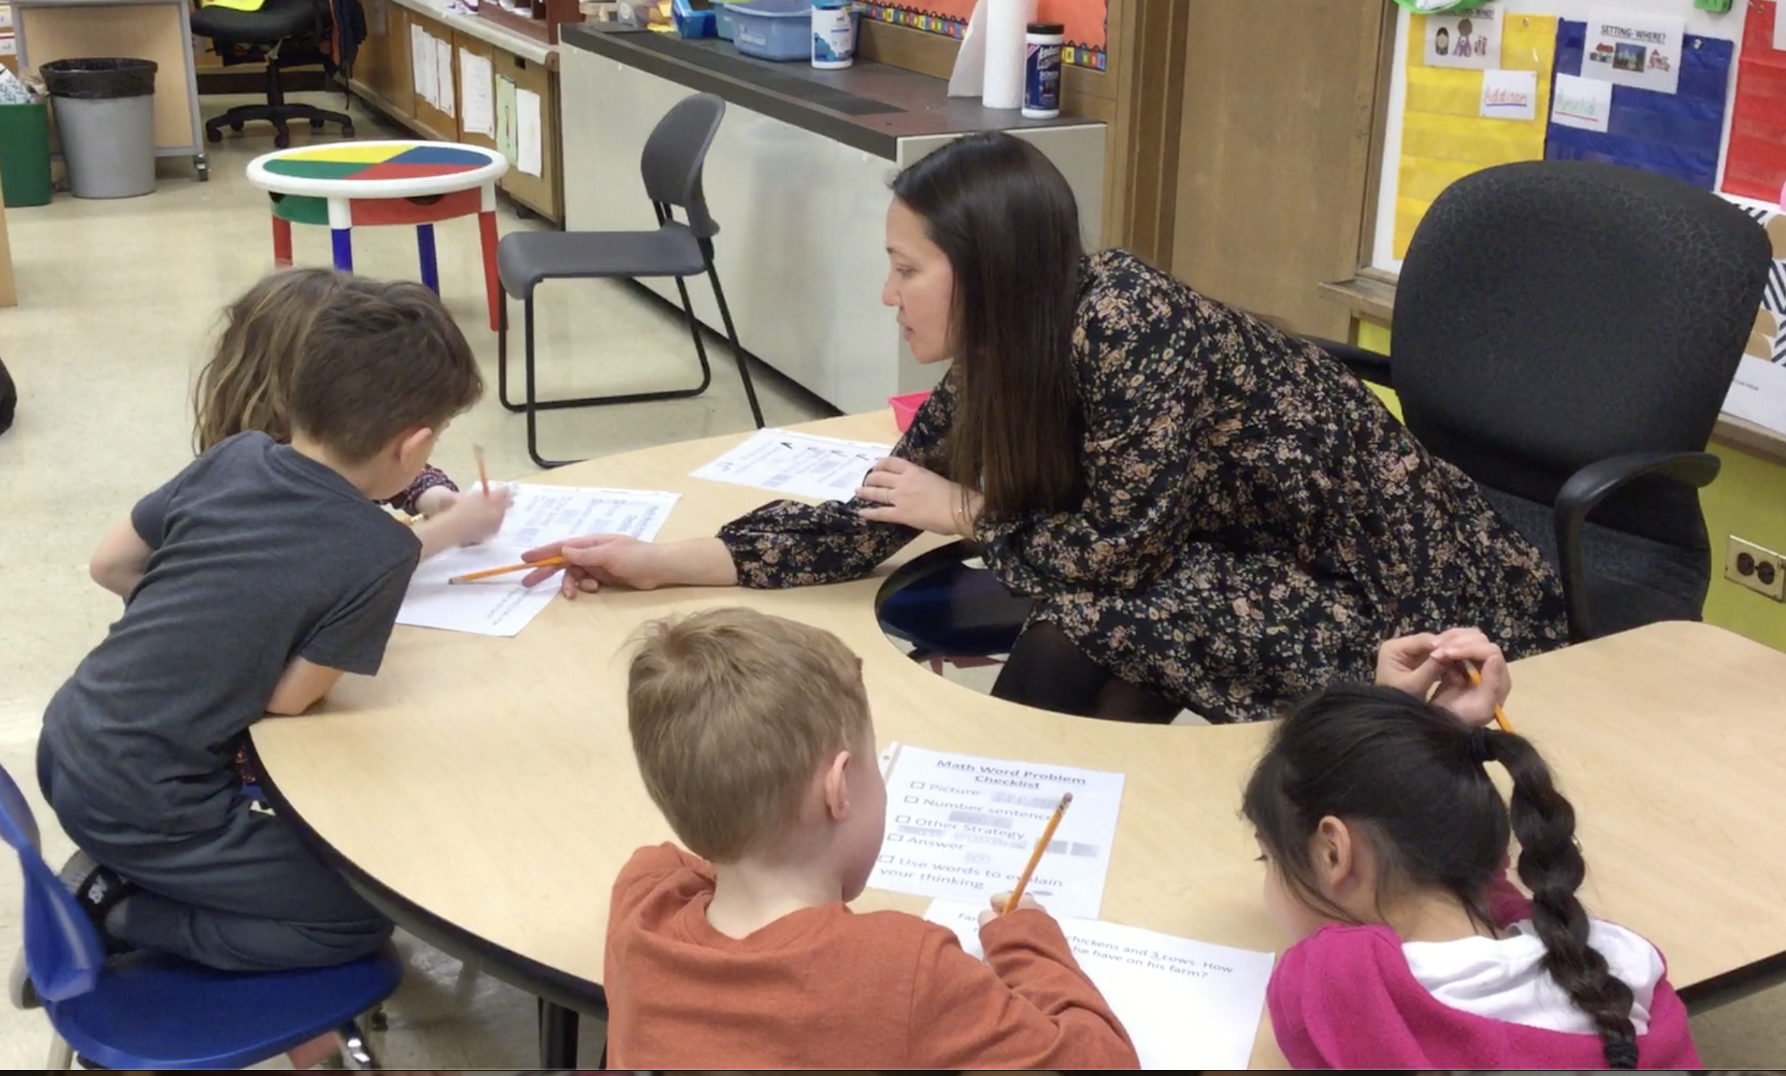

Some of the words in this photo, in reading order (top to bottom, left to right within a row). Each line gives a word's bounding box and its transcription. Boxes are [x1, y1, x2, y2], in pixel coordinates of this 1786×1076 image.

[935, 760, 975, 772] Math
[980, 766, 1019, 778] Word
[1024, 771, 1086, 785] Problem
[974, 775, 1040, 790] Checklist
[929, 782, 980, 797] Picture
[923, 798, 983, 812] Number
[915, 817, 957, 830] Other
[963, 823, 1026, 840] Strategy
[907, 836, 965, 850] Answer
[880, 867, 918, 880] your
[920, 870, 984, 890] thinking
[898, 857, 928, 868] Use
[933, 863, 980, 876] words
[985, 868, 1001, 879] to
[1006, 872, 1063, 887] exlain
[1067, 935, 1119, 951] chickens
[1123, 945, 1148, 957] and
[1151, 951, 1159, 960] 3
[1162, 954, 1198, 967] cows.
[1203, 961, 1233, 974] How
[1092, 950, 1123, 962] have
[1126, 958, 1143, 966] on
[1147, 960, 1166, 971] his
[1169, 964, 1208, 979] farm?
